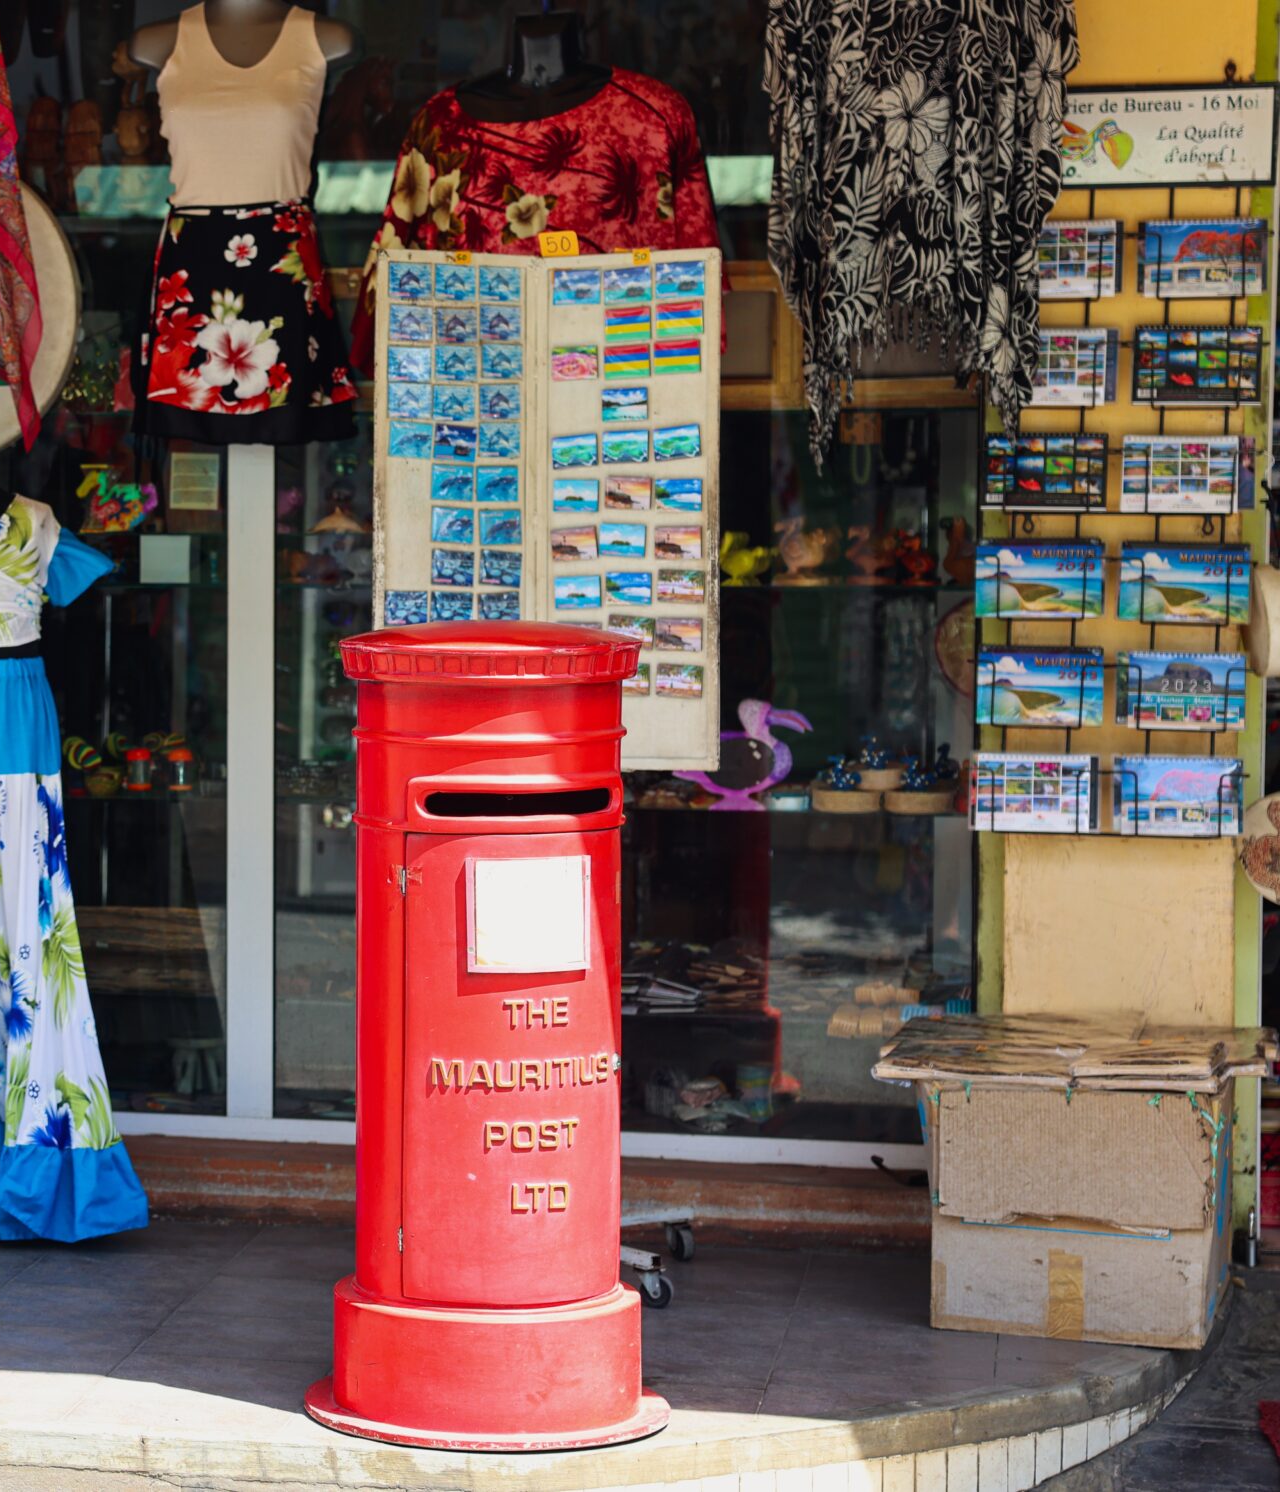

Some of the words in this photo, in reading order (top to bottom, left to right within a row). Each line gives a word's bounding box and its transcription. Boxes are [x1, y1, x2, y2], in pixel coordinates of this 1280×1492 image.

[1099, 97, 1118, 113] de
[1124, 96, 1182, 113] Bureau
[1202, 96, 1220, 111] 16
[1155, 126, 1178, 141] La
[1184, 120, 1244, 143] Qualité
[1164, 144, 1224, 164] d'abord
[545, 236, 572, 253] 50
[634, 252, 648, 261] 50
[1160, 678, 1213, 693] 2023
[502, 997, 569, 1030] THE
[430, 1053, 608, 1091] MAURITIUS
[484, 1118, 580, 1153] POST
[511, 1181, 570, 1213] LTD
